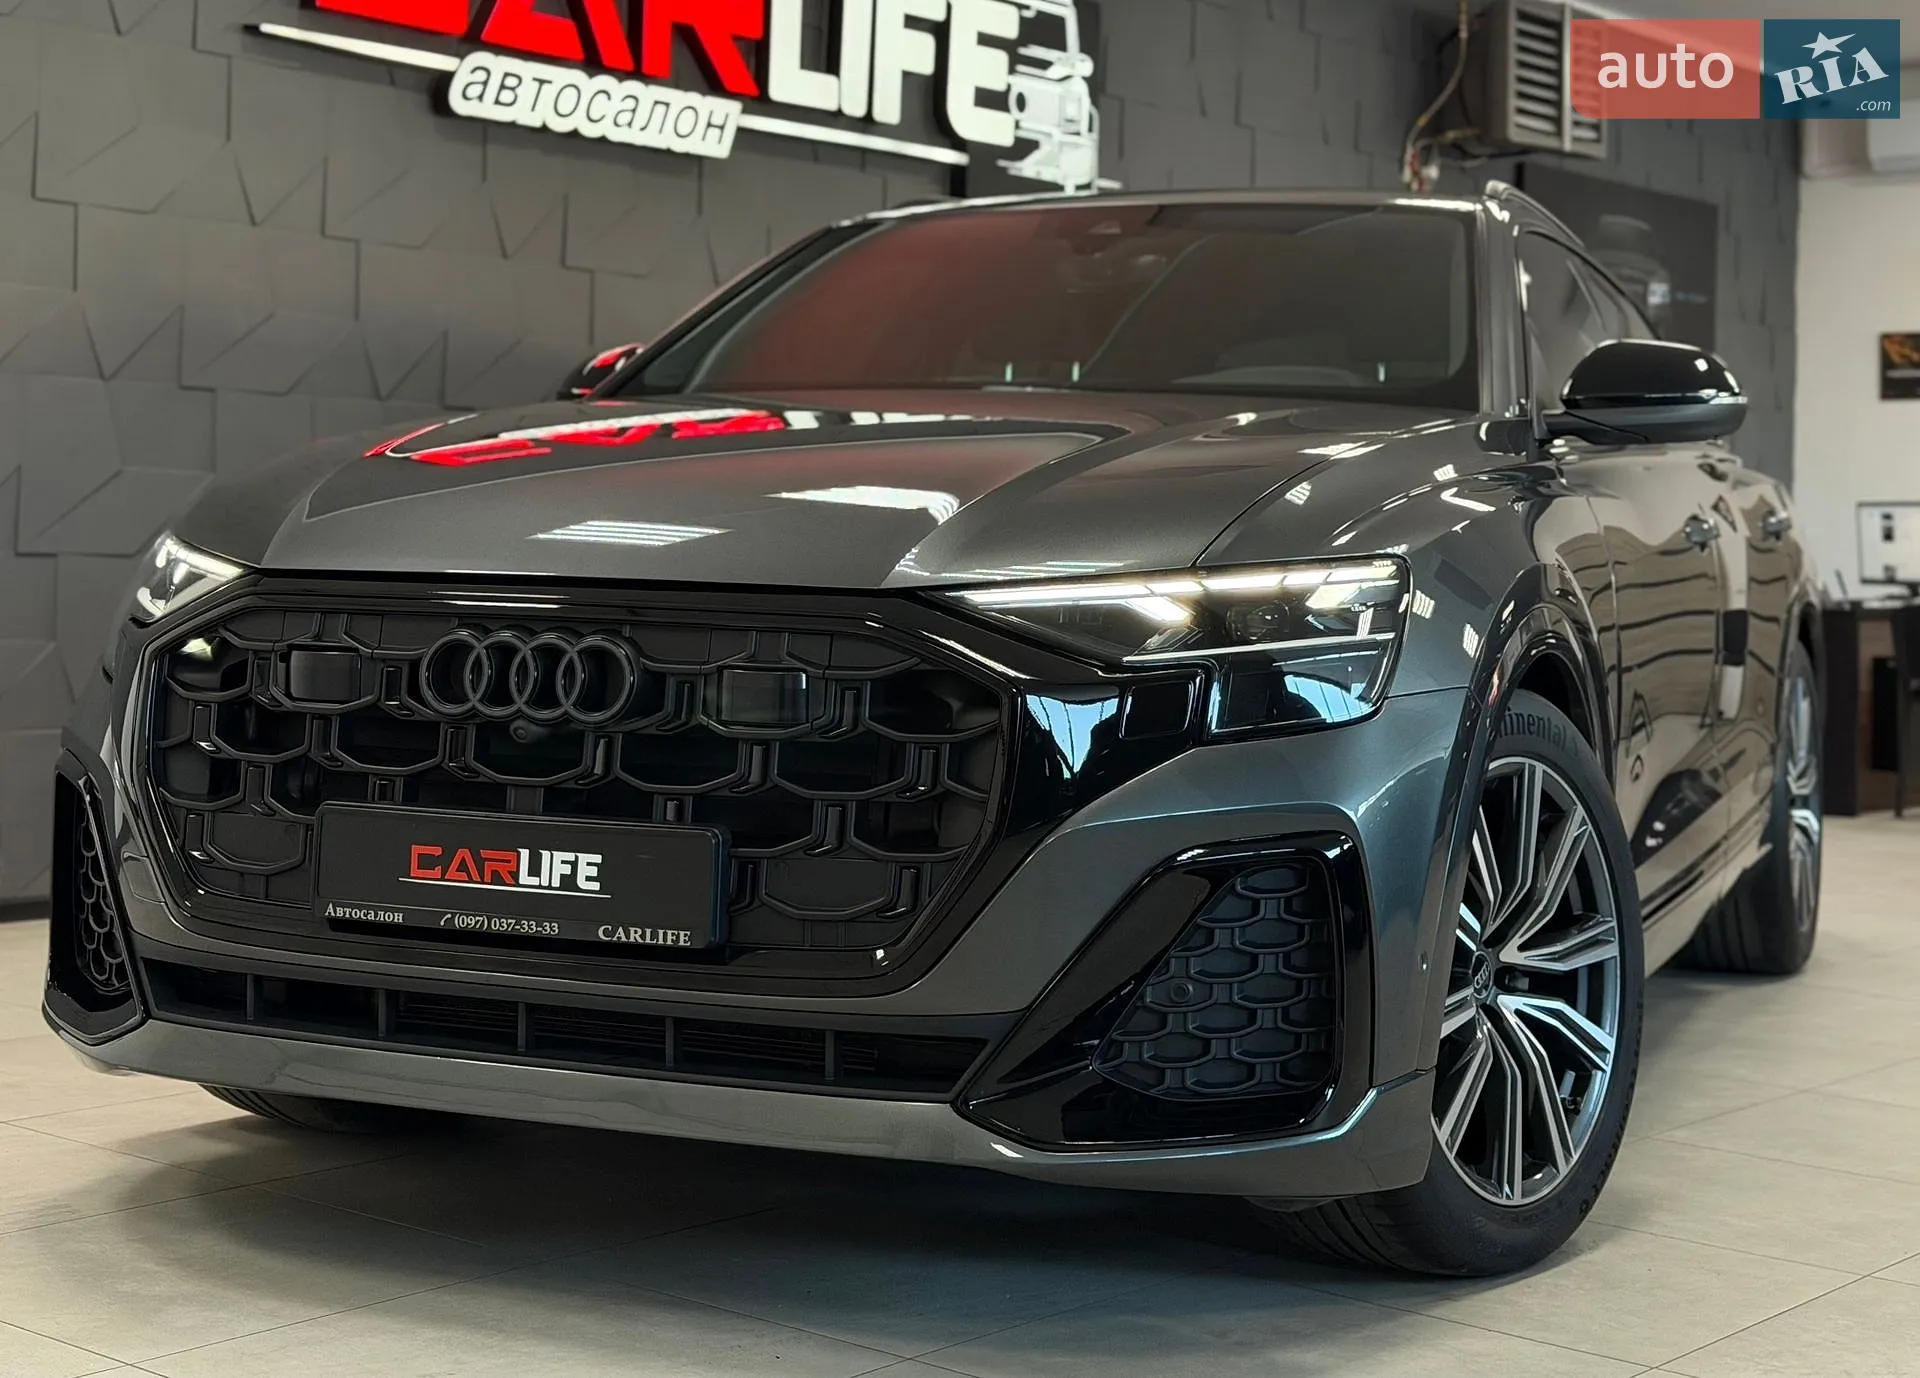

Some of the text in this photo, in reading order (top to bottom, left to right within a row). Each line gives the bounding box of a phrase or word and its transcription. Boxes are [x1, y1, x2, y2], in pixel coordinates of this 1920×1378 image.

[461, 65, 732, 145] автосалон
[410, 844, 602, 891] CARLIFE
[324, 902, 691, 946] Автосалон (097) 037-33-33 CARLIFE
